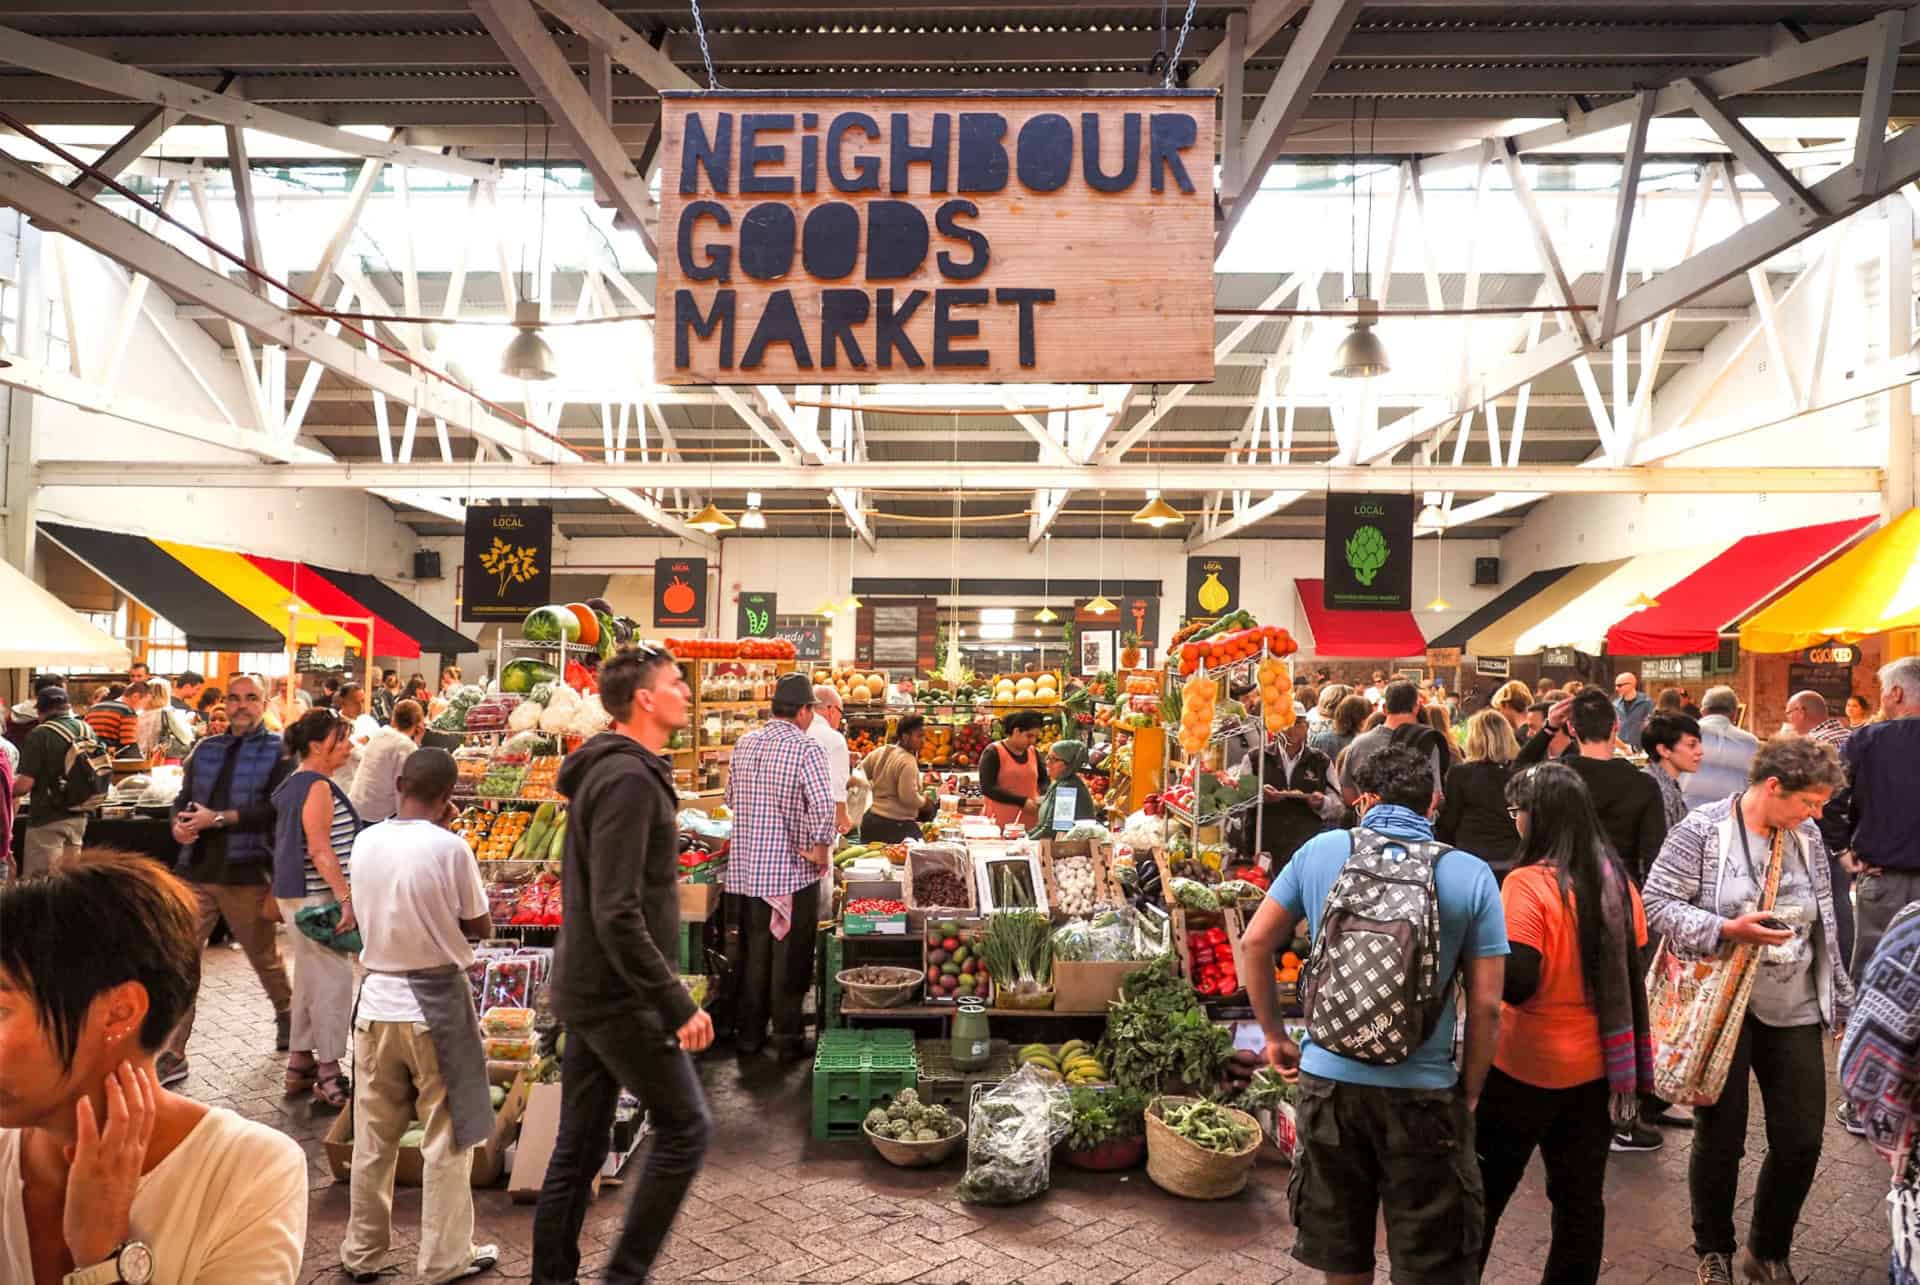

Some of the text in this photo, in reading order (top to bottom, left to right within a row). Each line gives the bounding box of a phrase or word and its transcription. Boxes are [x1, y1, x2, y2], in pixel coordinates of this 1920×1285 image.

[676, 200, 991, 281] GOODS
[674, 287, 1057, 370] MARKET
[492, 518, 525, 528] LOCAL
[1353, 505, 1385, 516] LOCAL
